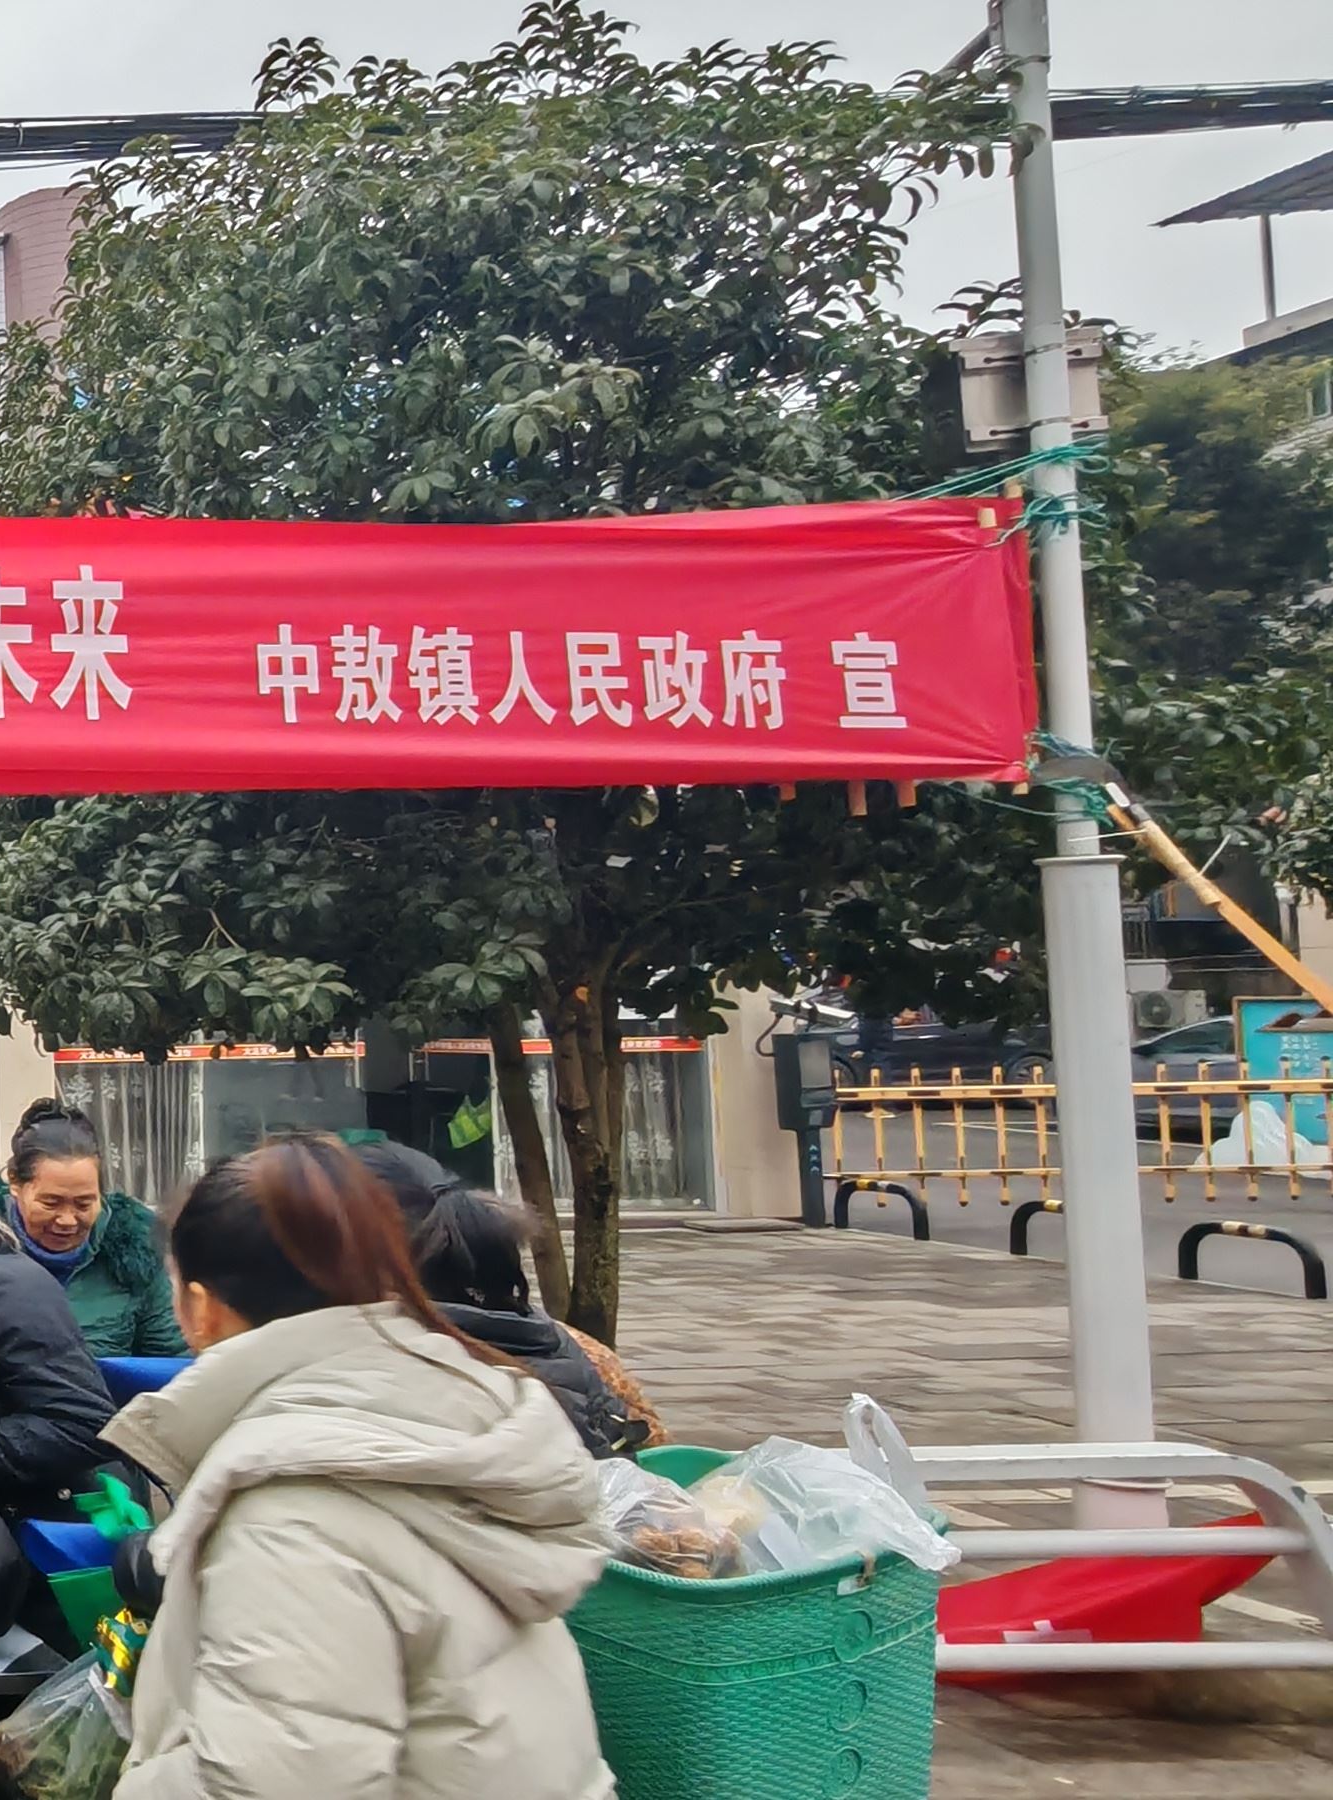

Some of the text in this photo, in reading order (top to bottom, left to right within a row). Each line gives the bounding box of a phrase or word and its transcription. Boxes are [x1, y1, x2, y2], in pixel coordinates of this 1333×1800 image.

[255, 622, 788, 731] 中敖镇人民政府
[829, 630, 909, 730] 宣
